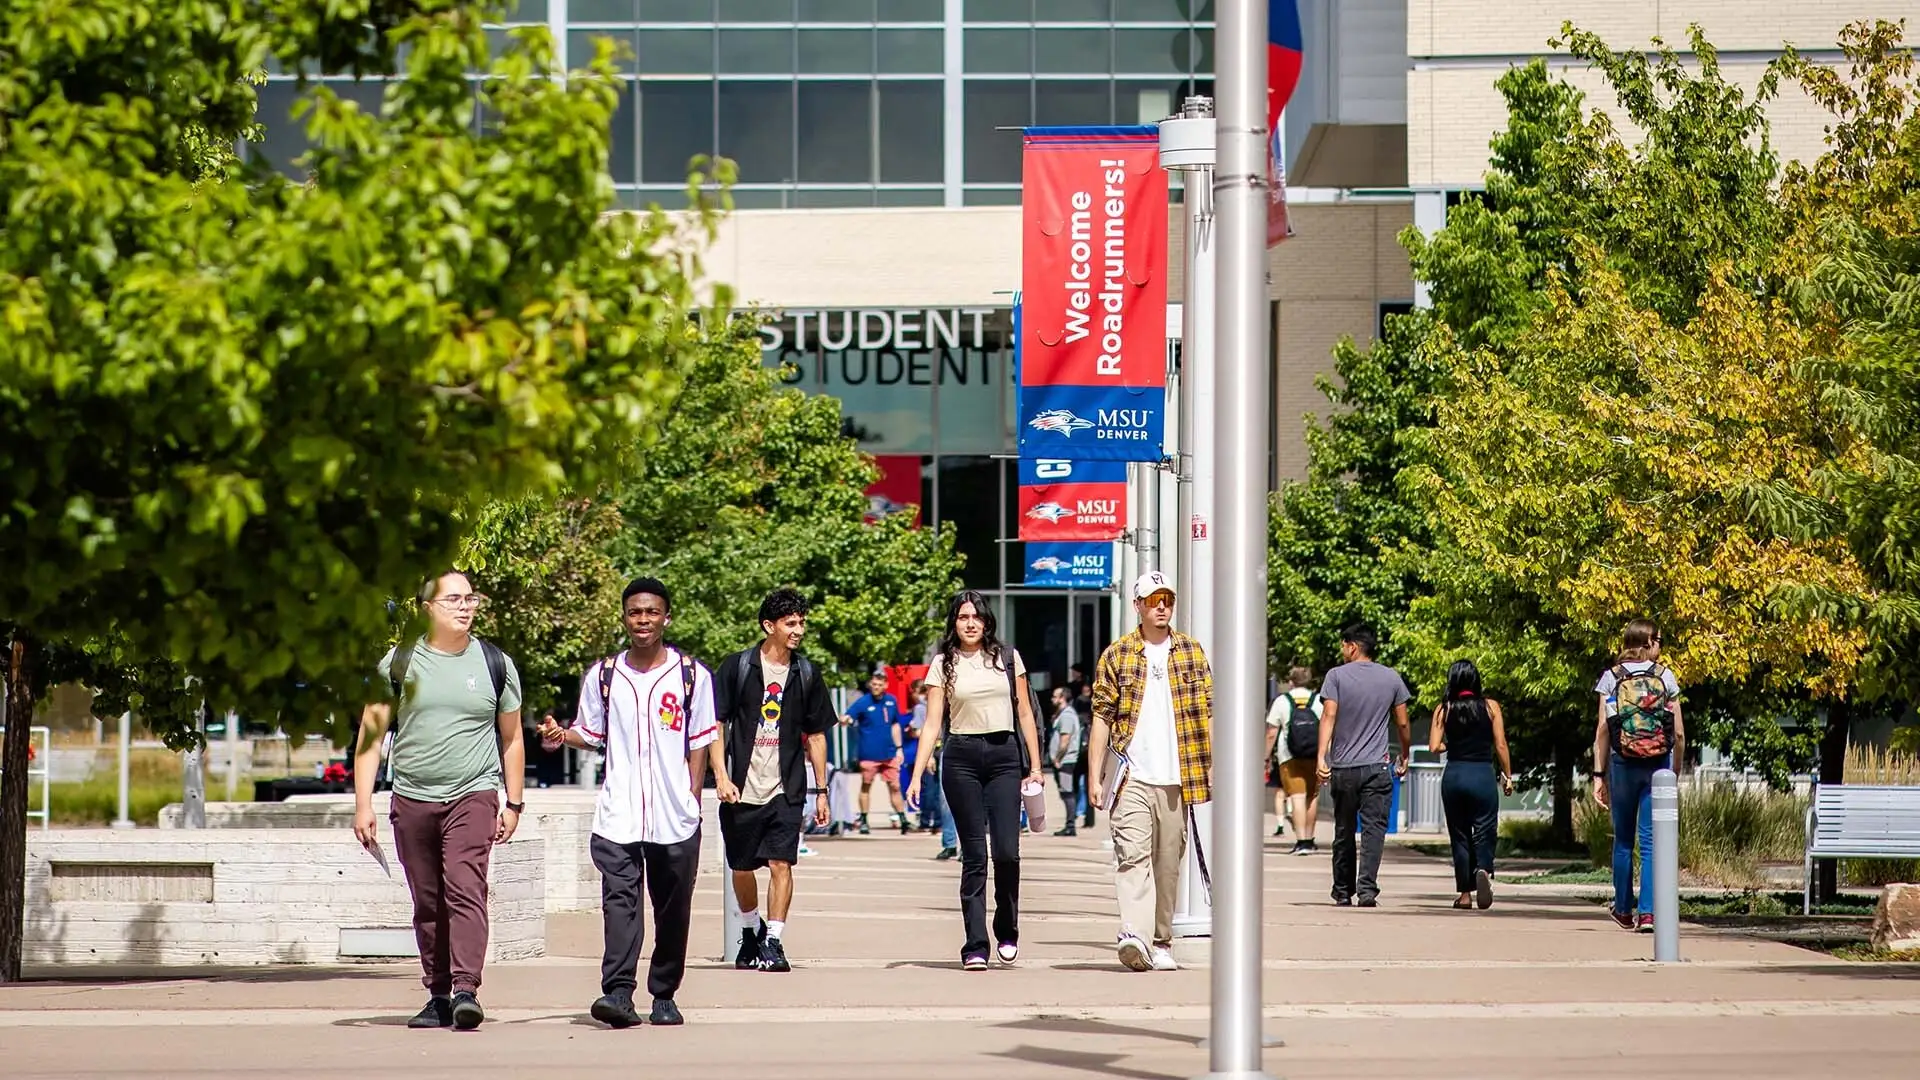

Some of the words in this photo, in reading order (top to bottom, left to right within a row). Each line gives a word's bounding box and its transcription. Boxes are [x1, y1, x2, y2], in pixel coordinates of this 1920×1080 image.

[1065, 191, 1092, 344] Welcome
[1097, 159, 1126, 376] Roadrunners!
[759, 309, 995, 350] STUDENT
[1098, 409, 1148, 428] MSU
[1097, 430, 1148, 440] DENVER
[1077, 501, 1116, 515] MSU
[1077, 516, 1117, 524] DENVER
[1073, 556, 1104, 567] MSU
